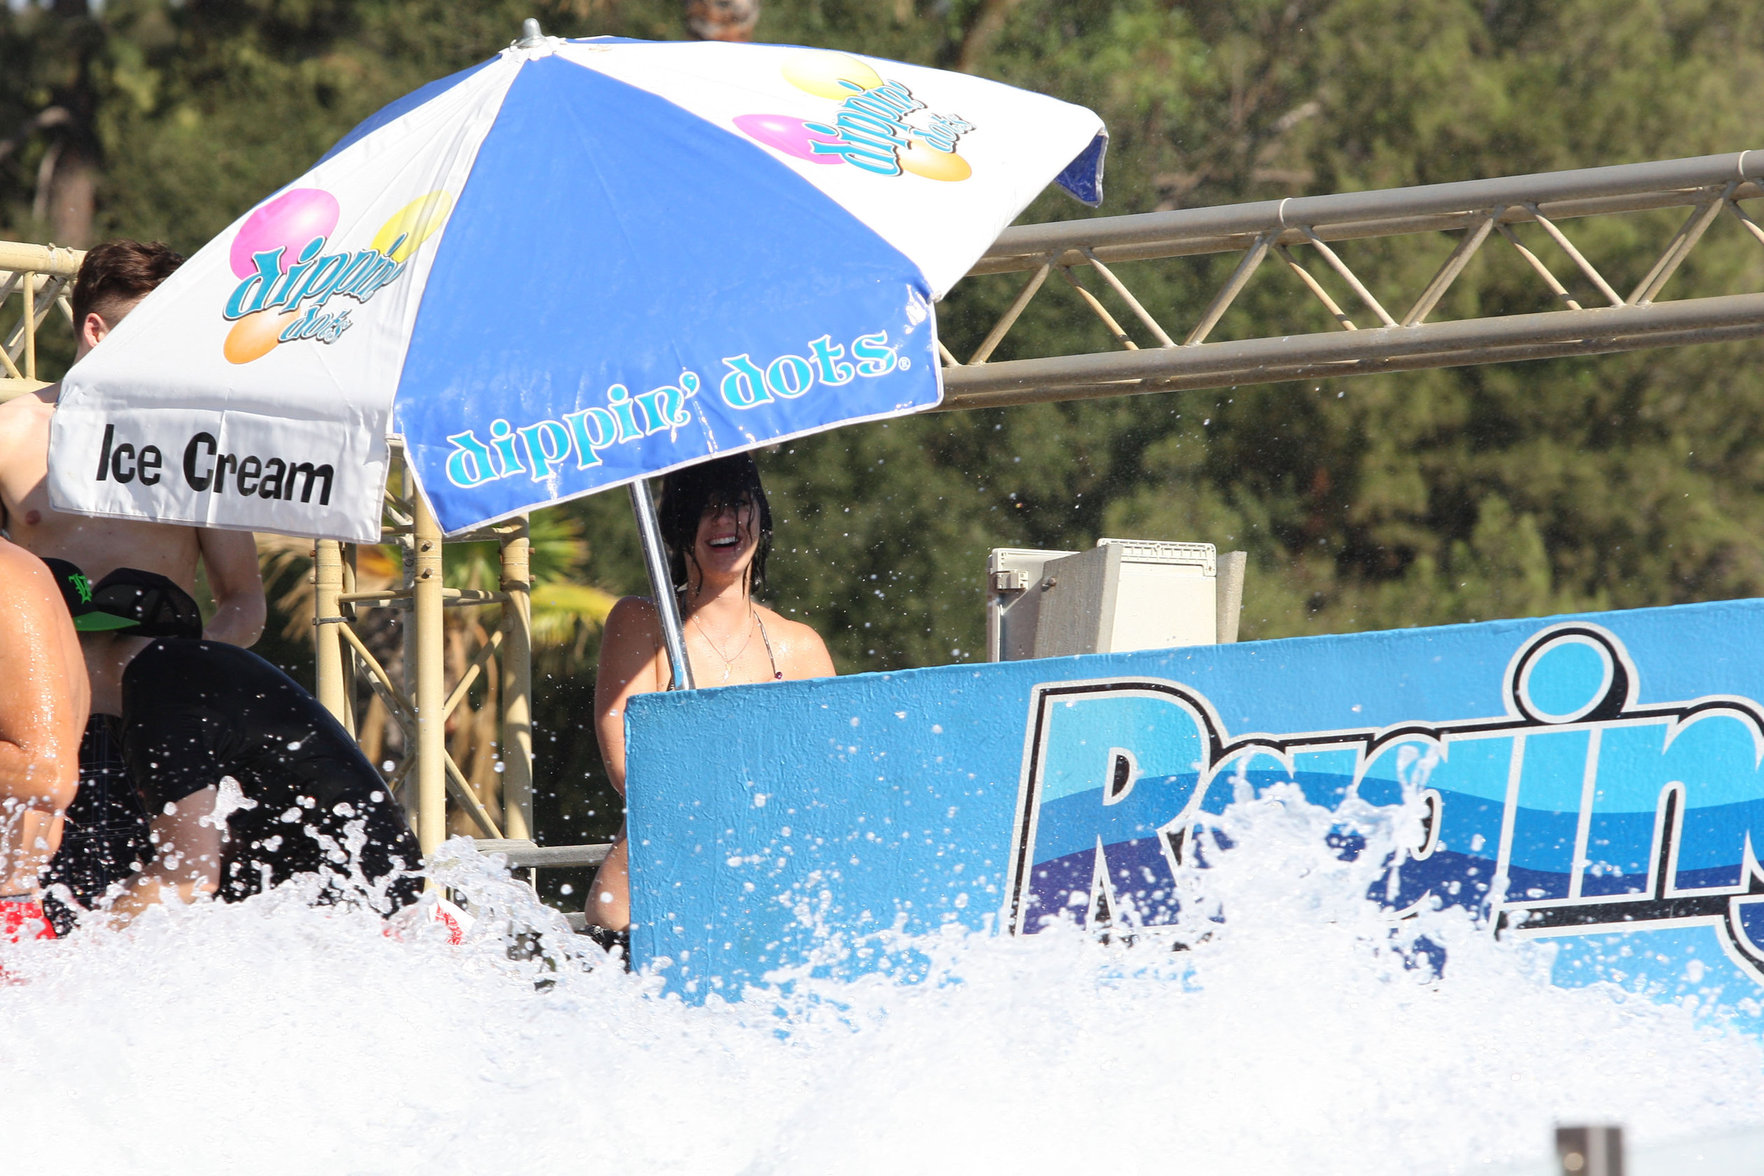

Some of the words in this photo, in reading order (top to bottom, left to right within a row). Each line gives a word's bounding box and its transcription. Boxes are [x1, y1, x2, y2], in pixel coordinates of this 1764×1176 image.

[96, 423, 162, 486] Ice
[183, 431, 335, 506] Cream
[444, 371, 701, 489] dippin'
